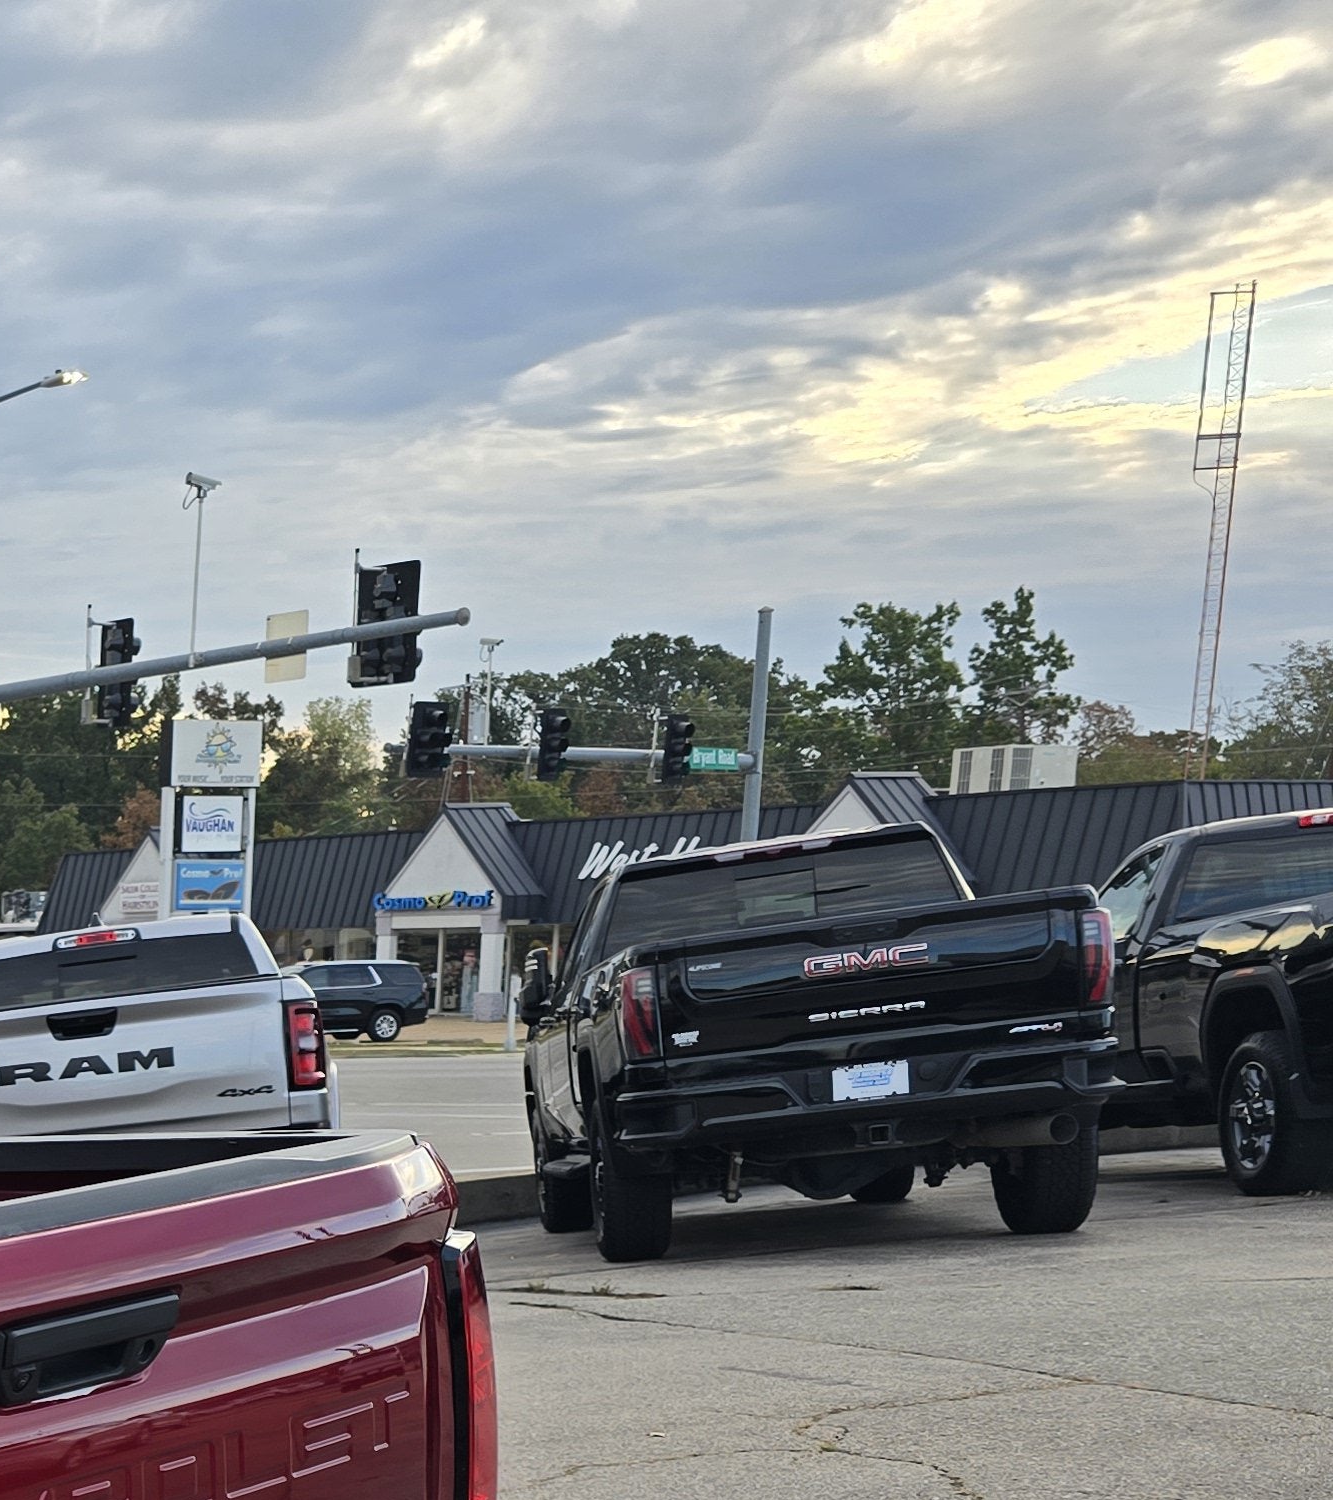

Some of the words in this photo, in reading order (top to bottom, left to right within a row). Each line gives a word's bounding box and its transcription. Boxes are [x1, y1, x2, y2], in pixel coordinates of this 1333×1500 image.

[718, 748, 735, 764] Road
[186, 818, 234, 833] VAUGHAN
[181, 867, 210, 878] Cosmo
[373, 892, 427, 911] Cosmo
[452, 890, 494, 907] Prof
[803, 942, 929, 978] GMC
[808, 1000, 926, 1024] SIERRA
